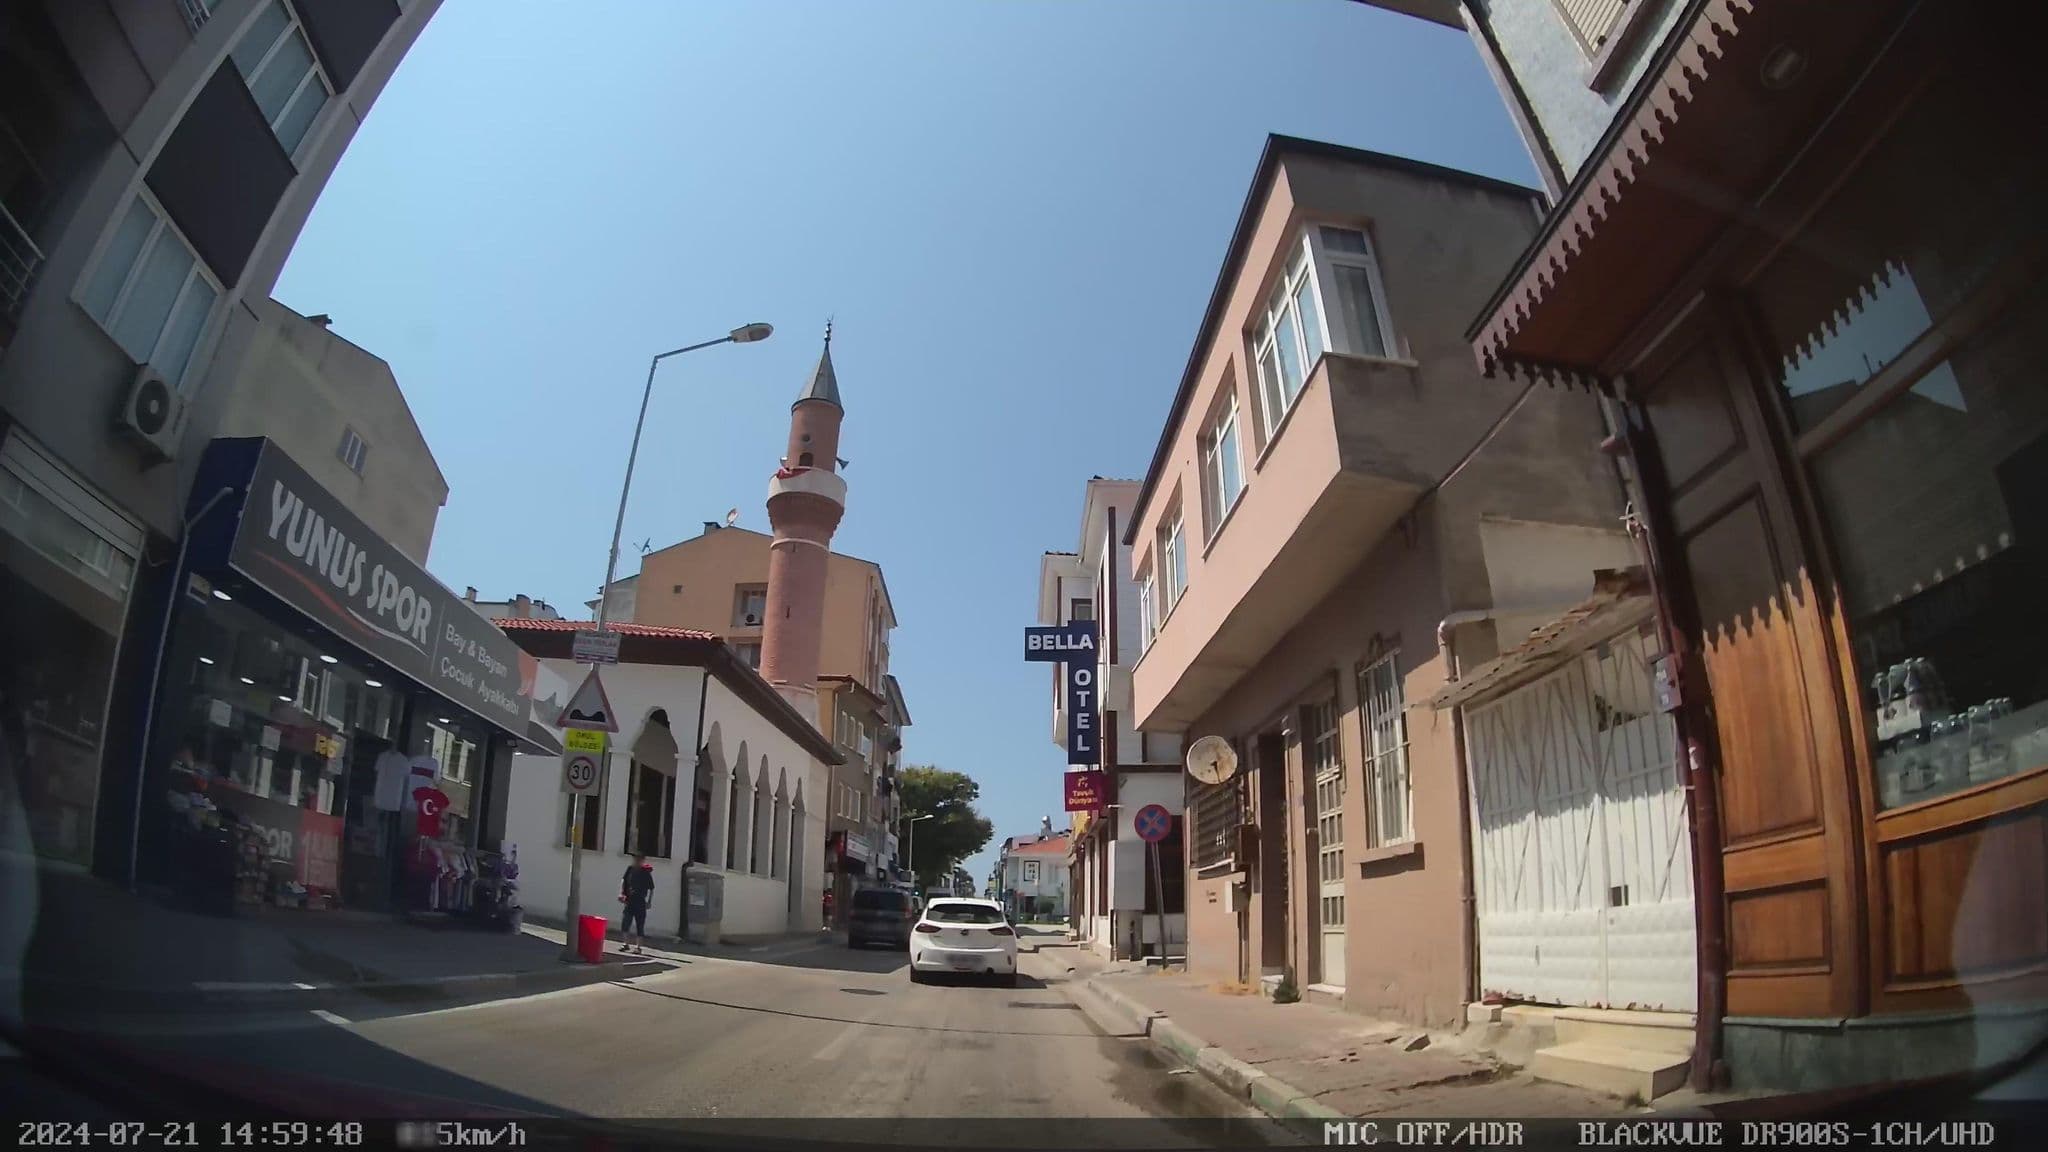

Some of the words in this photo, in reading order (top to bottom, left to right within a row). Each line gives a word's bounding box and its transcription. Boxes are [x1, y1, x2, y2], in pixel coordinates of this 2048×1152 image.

[268, 479, 367, 597] YUNUS
[366, 564, 432, 645] SPOR
[446, 623, 467, 654] Bay
[468, 640, 476, 658] &
[1028, 633, 1094, 650] BELLA
[441, 656, 475, 688] Çocuk
[1074, 668, 1092, 752] OTEL
[571, 764, 591, 781] 30
